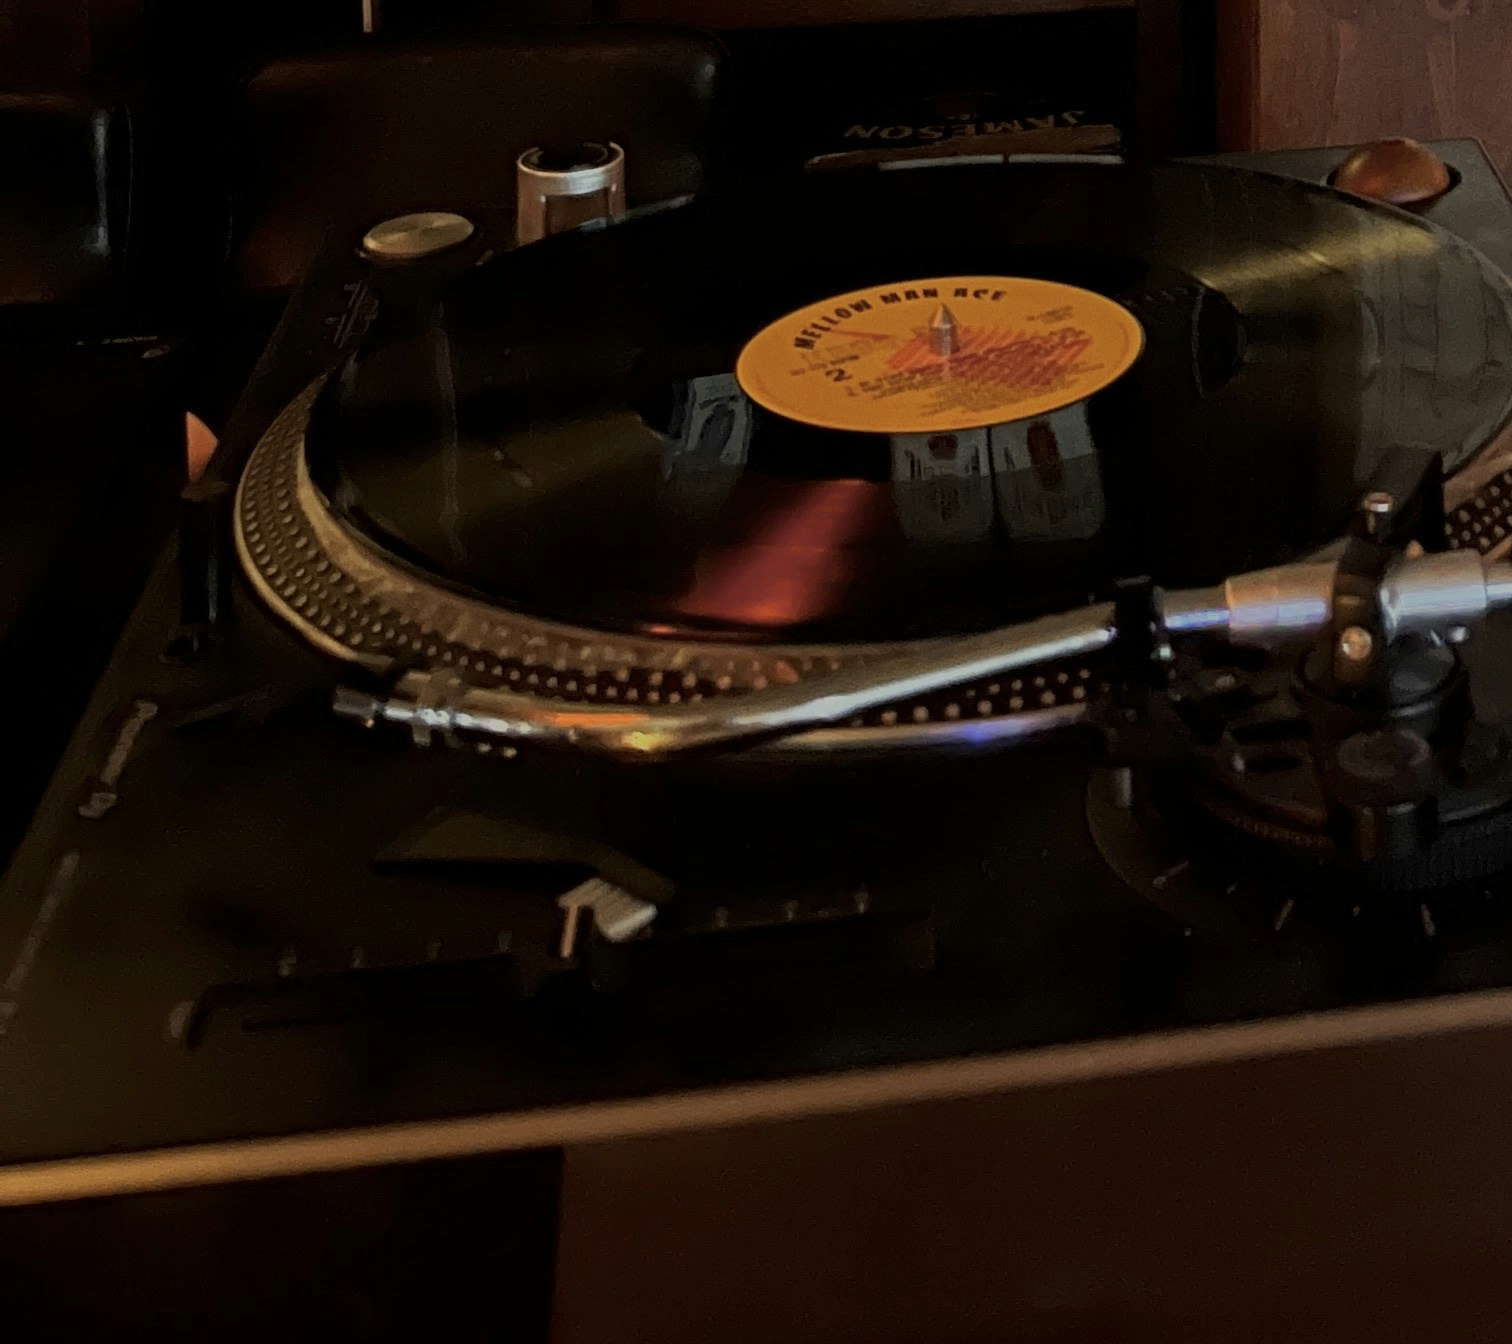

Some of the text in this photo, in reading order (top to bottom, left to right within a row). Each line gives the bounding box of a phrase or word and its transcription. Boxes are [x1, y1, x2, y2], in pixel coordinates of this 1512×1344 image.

[793, 287, 1007, 351] MELLOW MAN ACE
